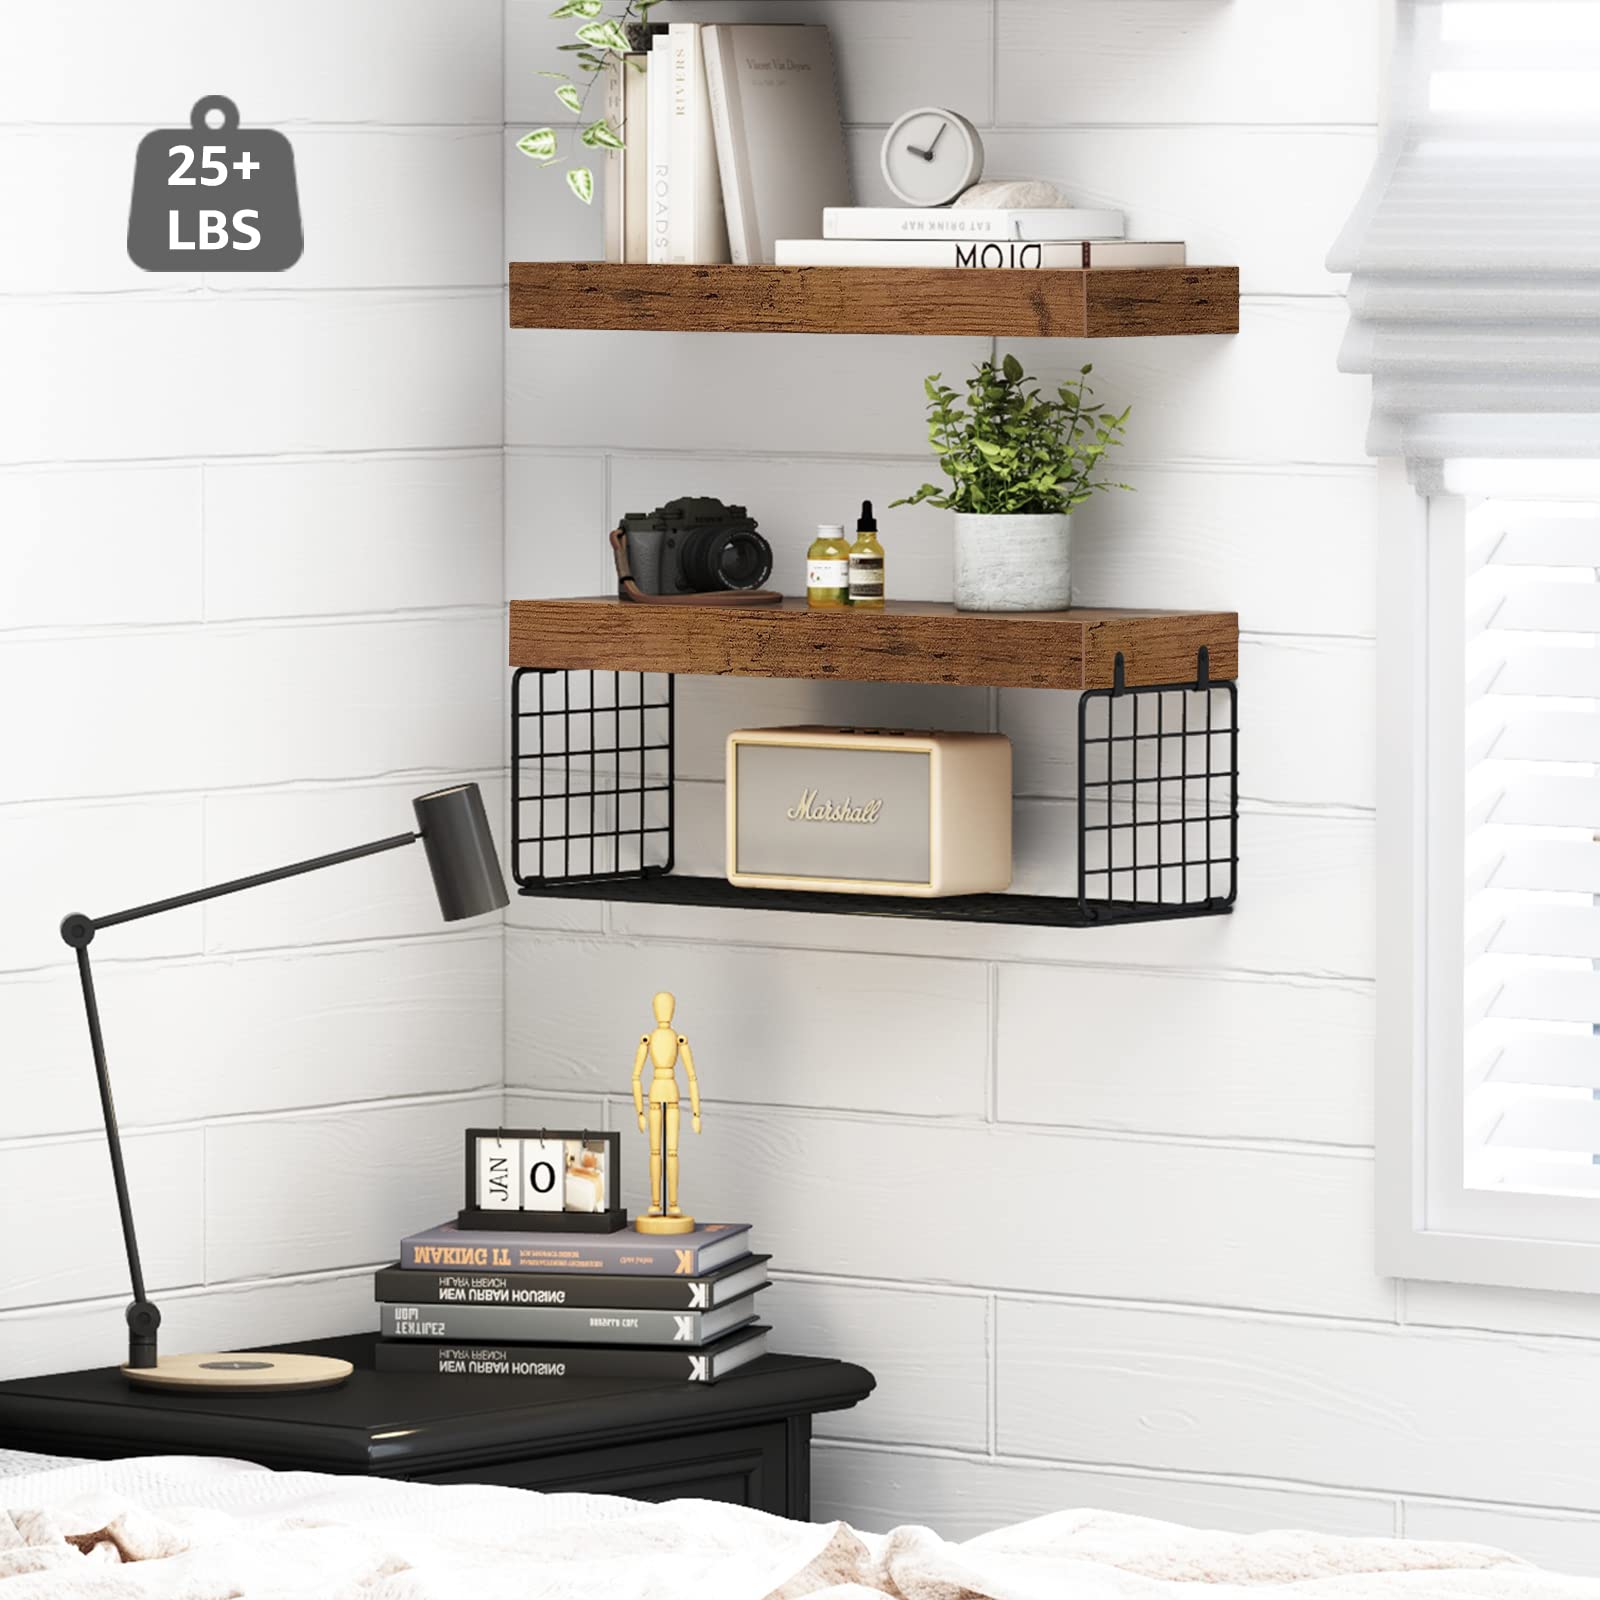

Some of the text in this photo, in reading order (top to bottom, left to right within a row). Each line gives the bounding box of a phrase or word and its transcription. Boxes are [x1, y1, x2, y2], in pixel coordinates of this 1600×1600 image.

[655, 165, 669, 249] ROADS
[901, 221, 991, 231] EAT DRINK NAP
[787, 789, 883, 824] Marshall
[489, 1157, 508, 1202] JAN
